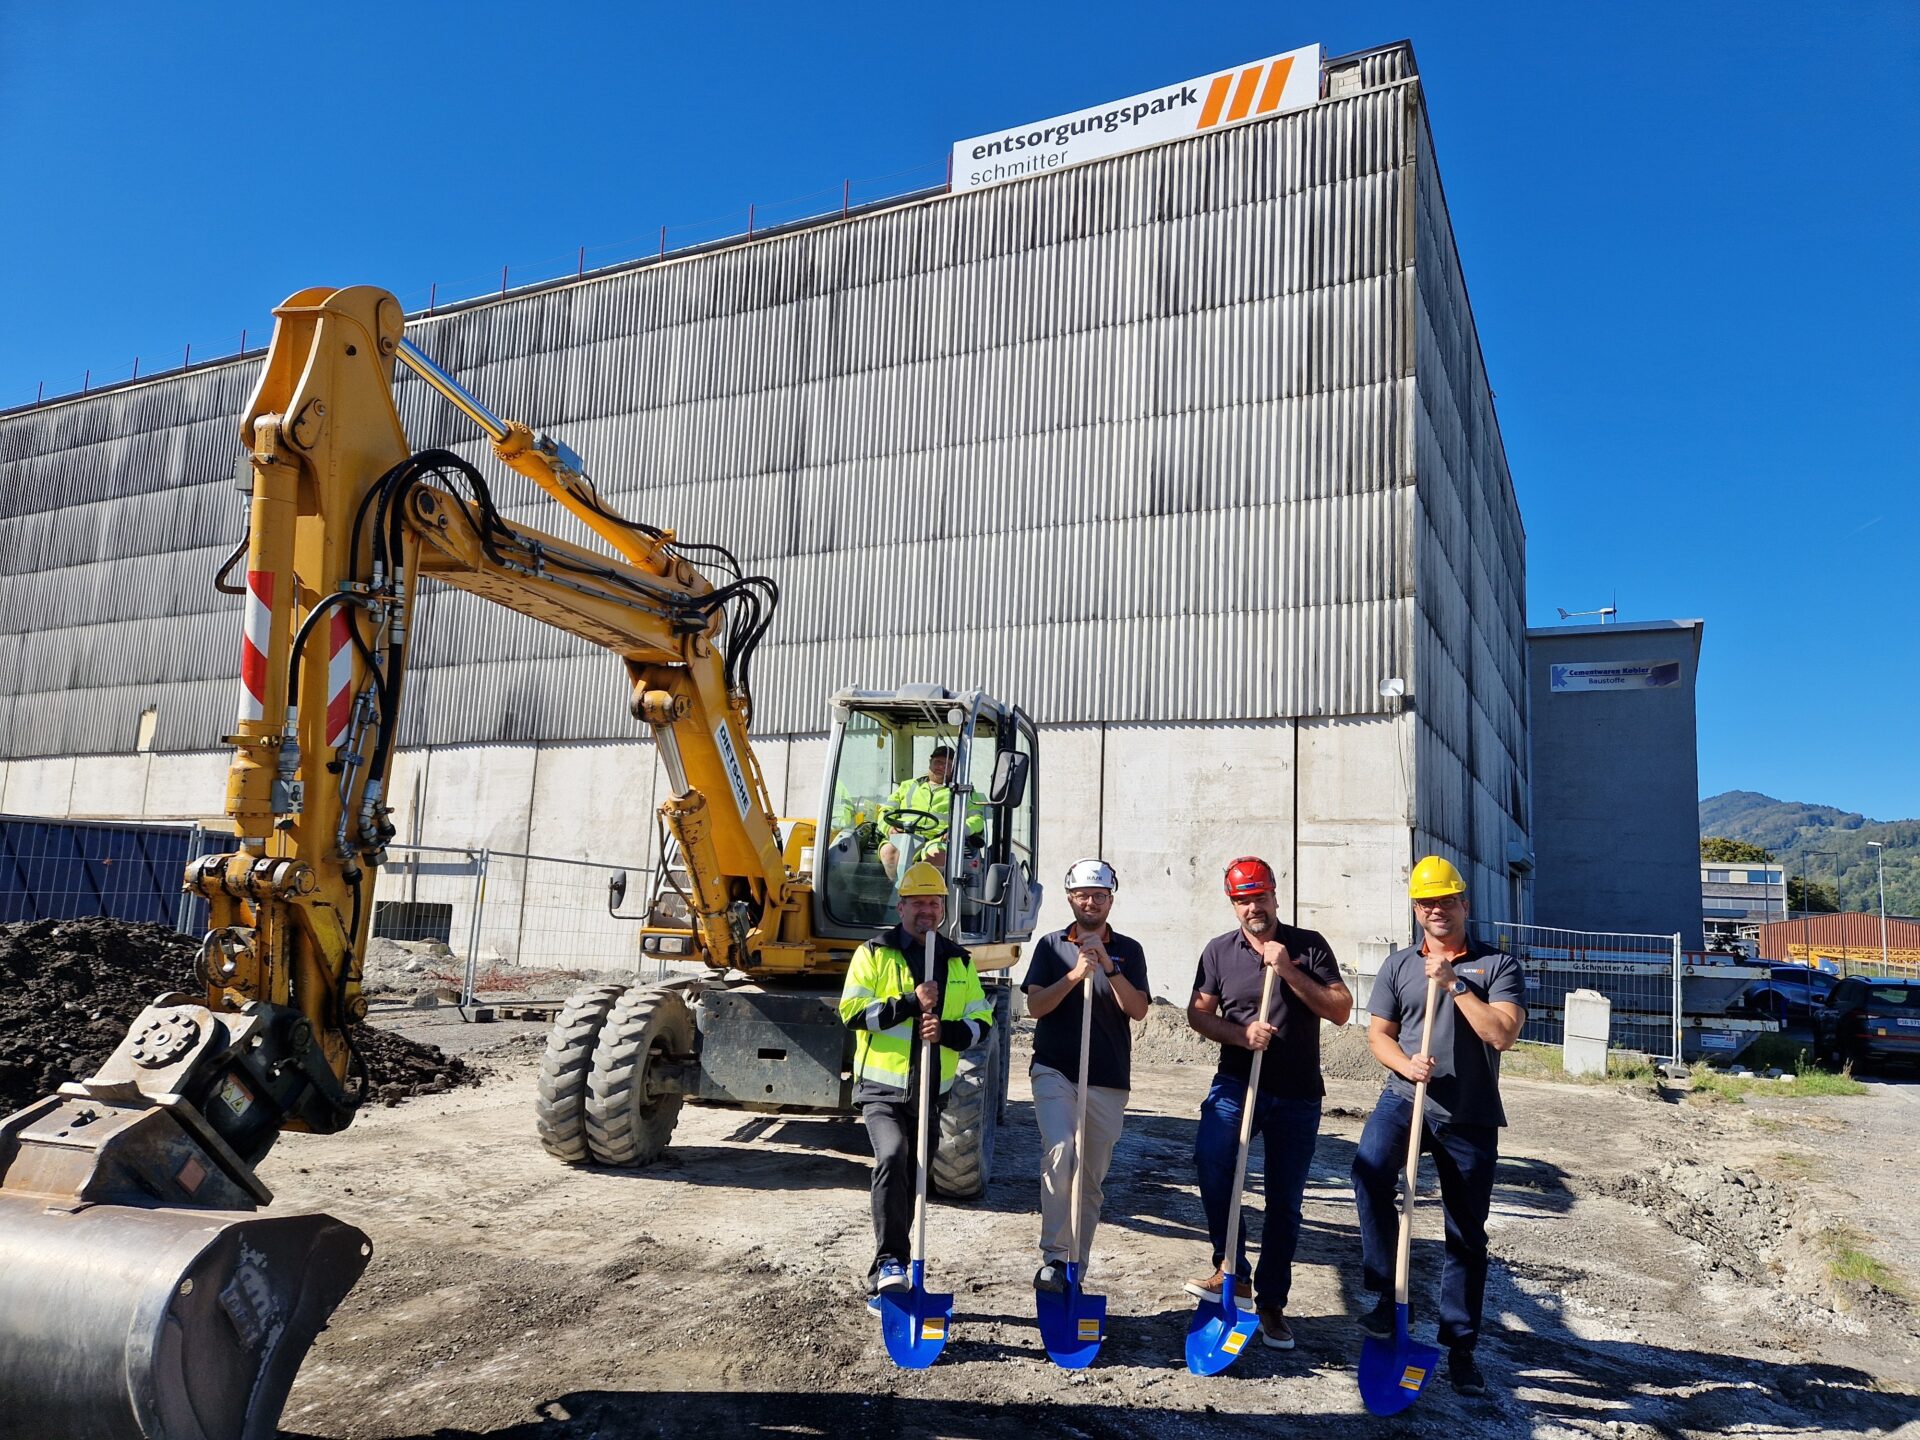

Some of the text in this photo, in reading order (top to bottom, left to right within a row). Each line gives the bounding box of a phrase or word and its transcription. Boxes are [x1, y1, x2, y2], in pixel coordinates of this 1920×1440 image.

[972, 86, 1198, 160] entsorgungspark
[970, 150, 1068, 186] schmitter
[1569, 668, 1621, 677] Cementwaren
[1588, 676, 1625, 685] Baustoffe
[719, 725, 750, 810] DIETSCHE
[1572, 963, 1635, 973] G.Schmitter AG
